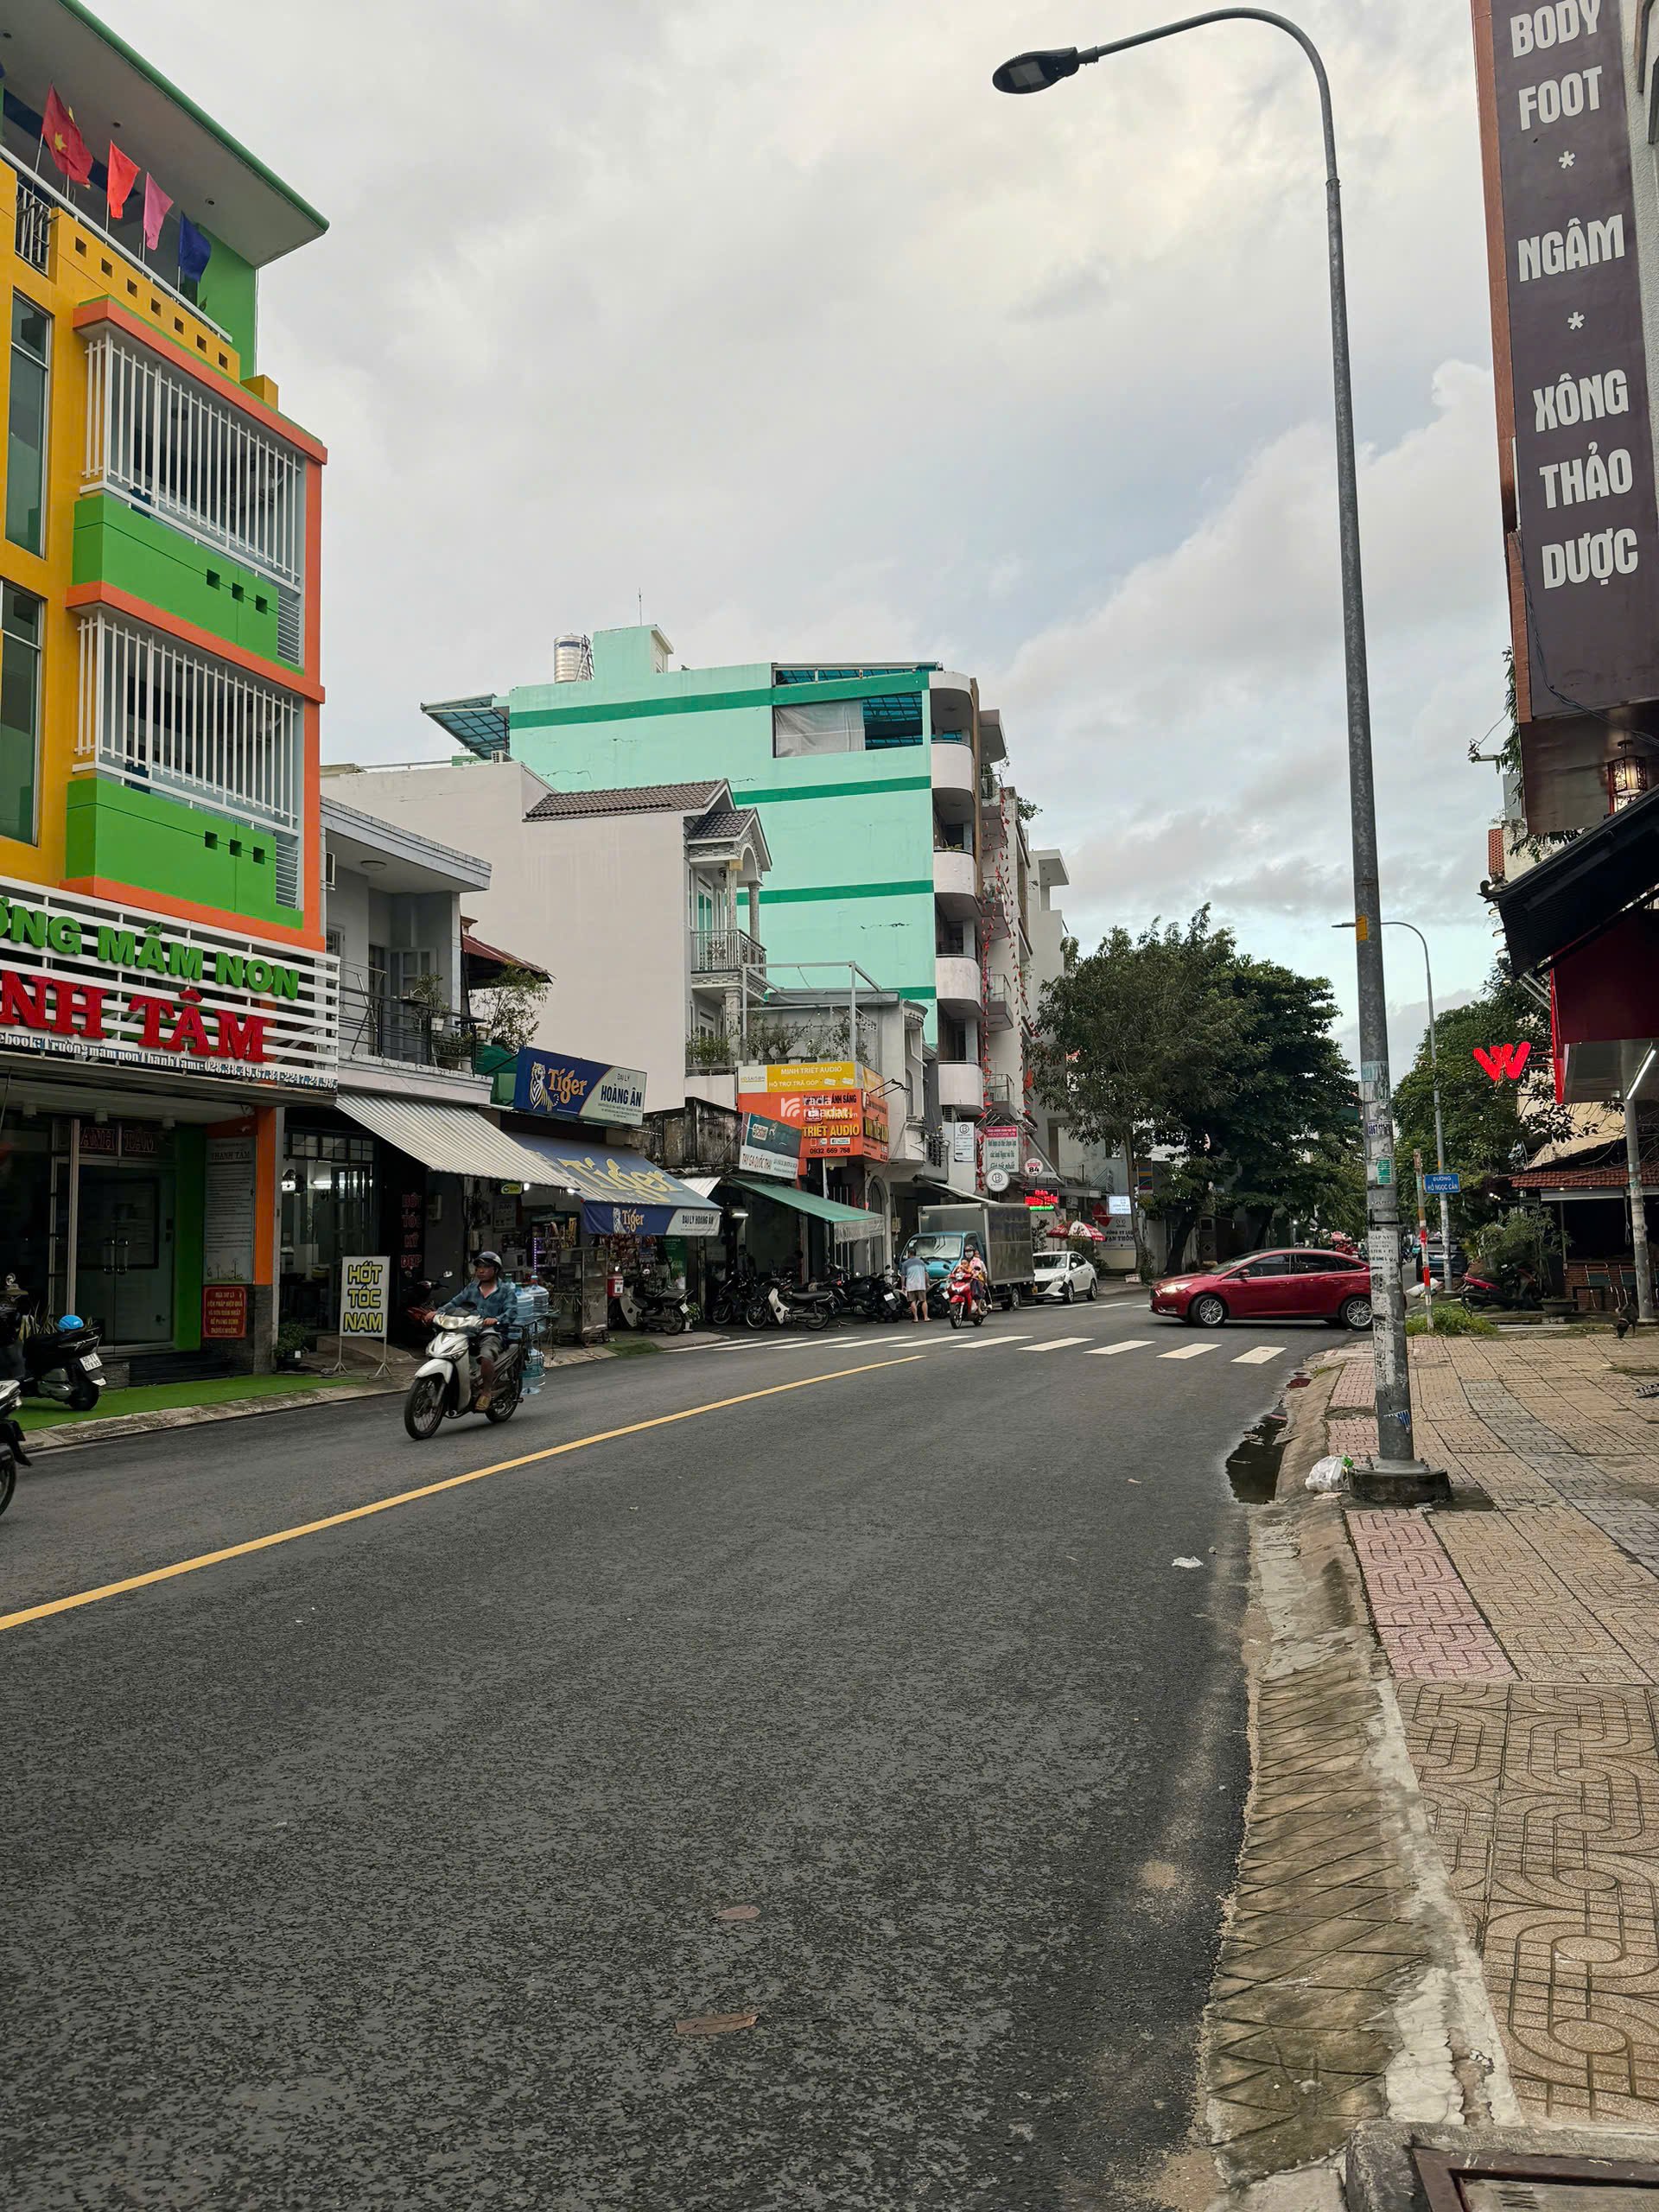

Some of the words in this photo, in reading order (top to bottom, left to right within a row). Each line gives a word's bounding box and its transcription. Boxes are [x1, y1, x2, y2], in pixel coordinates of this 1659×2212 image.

[1510, 0, 1600, 58] BODY
[1518, 65, 1603, 130] FOOT
[1517, 214, 1625, 283] NGÂM
[1532, 369, 1630, 432] XÔNG
[1539, 442, 1633, 509] THẢO
[1541, 527, 1638, 589] DƯỢC
[215, 951, 300, 1001] NON
[128, 988, 271, 1064] TÂM
[548, 1068, 588, 1104] Tiger
[800, 1065, 818, 1075] TRIẾT
[601, 1083, 629, 1105] HOÀNG
[630, 1087, 642, 1108] ÂN
[832, 1093, 842, 1103] ÁNH
[843, 1092, 857, 1103] SÁNG
[802, 1122, 828, 1138] TRIẾT
[830, 1124, 861, 1137] AUDIO
[556, 1157, 684, 1203] Tiger
[622, 1208, 645, 1232] Tiger
[347, 1261, 383, 1285] HỚT
[347, 1285, 381, 1308] TÓC
[343, 1312, 385, 1333] NAM
